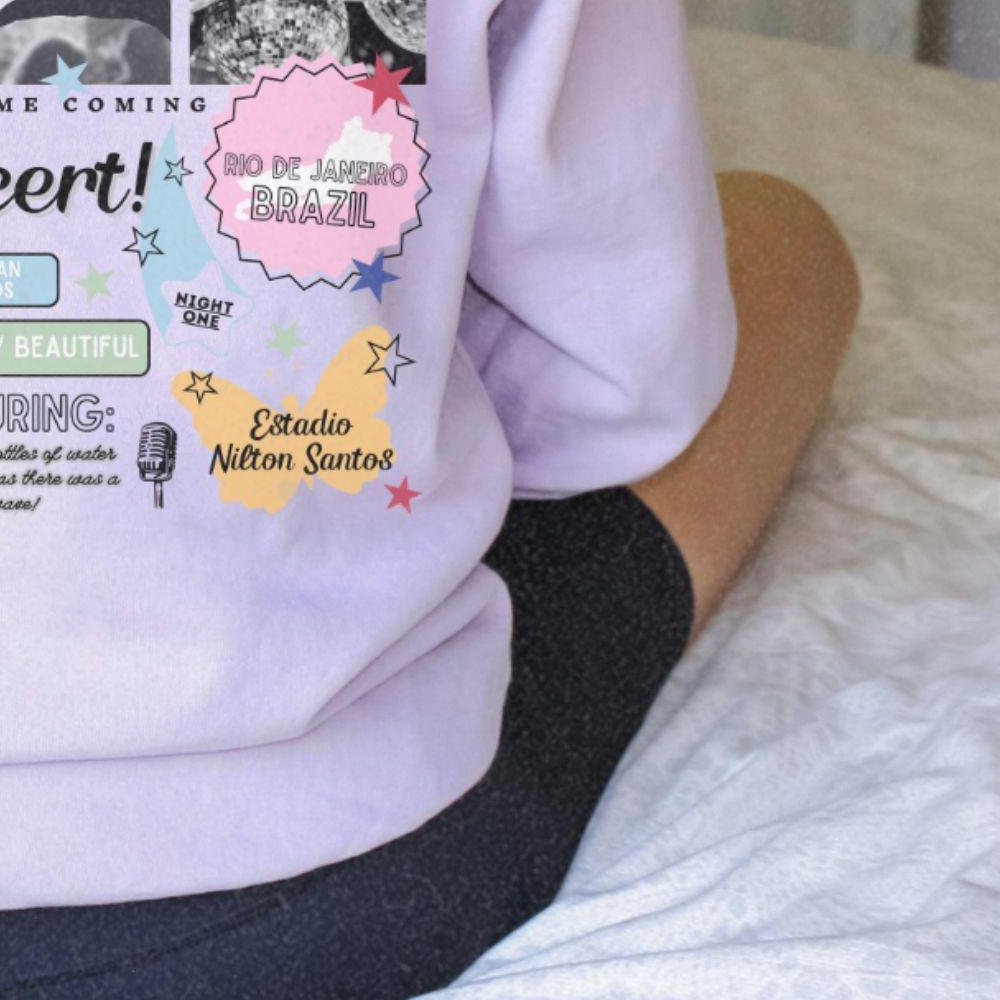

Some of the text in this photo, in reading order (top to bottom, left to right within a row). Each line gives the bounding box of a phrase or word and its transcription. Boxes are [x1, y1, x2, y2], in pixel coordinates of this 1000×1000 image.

[63, 97, 206, 112] COMING
[224, 152, 408, 187] RIO DE JANEIRO
[250, 185, 375, 228] BRAZIL
[174, 291, 234, 316] NIGHT
[182, 310, 220, 330] ONE
[15, 335, 140, 358] BEAUTIFUL
[250, 408, 353, 441] Estadio
[42, 446, 63, 465] of
[66, 444, 117, 461] water
[209, 442, 394, 475] Nilton Santos
[22, 470, 63, 485] there
[66, 474, 104, 485] was
[107, 475, 122, 485] a
